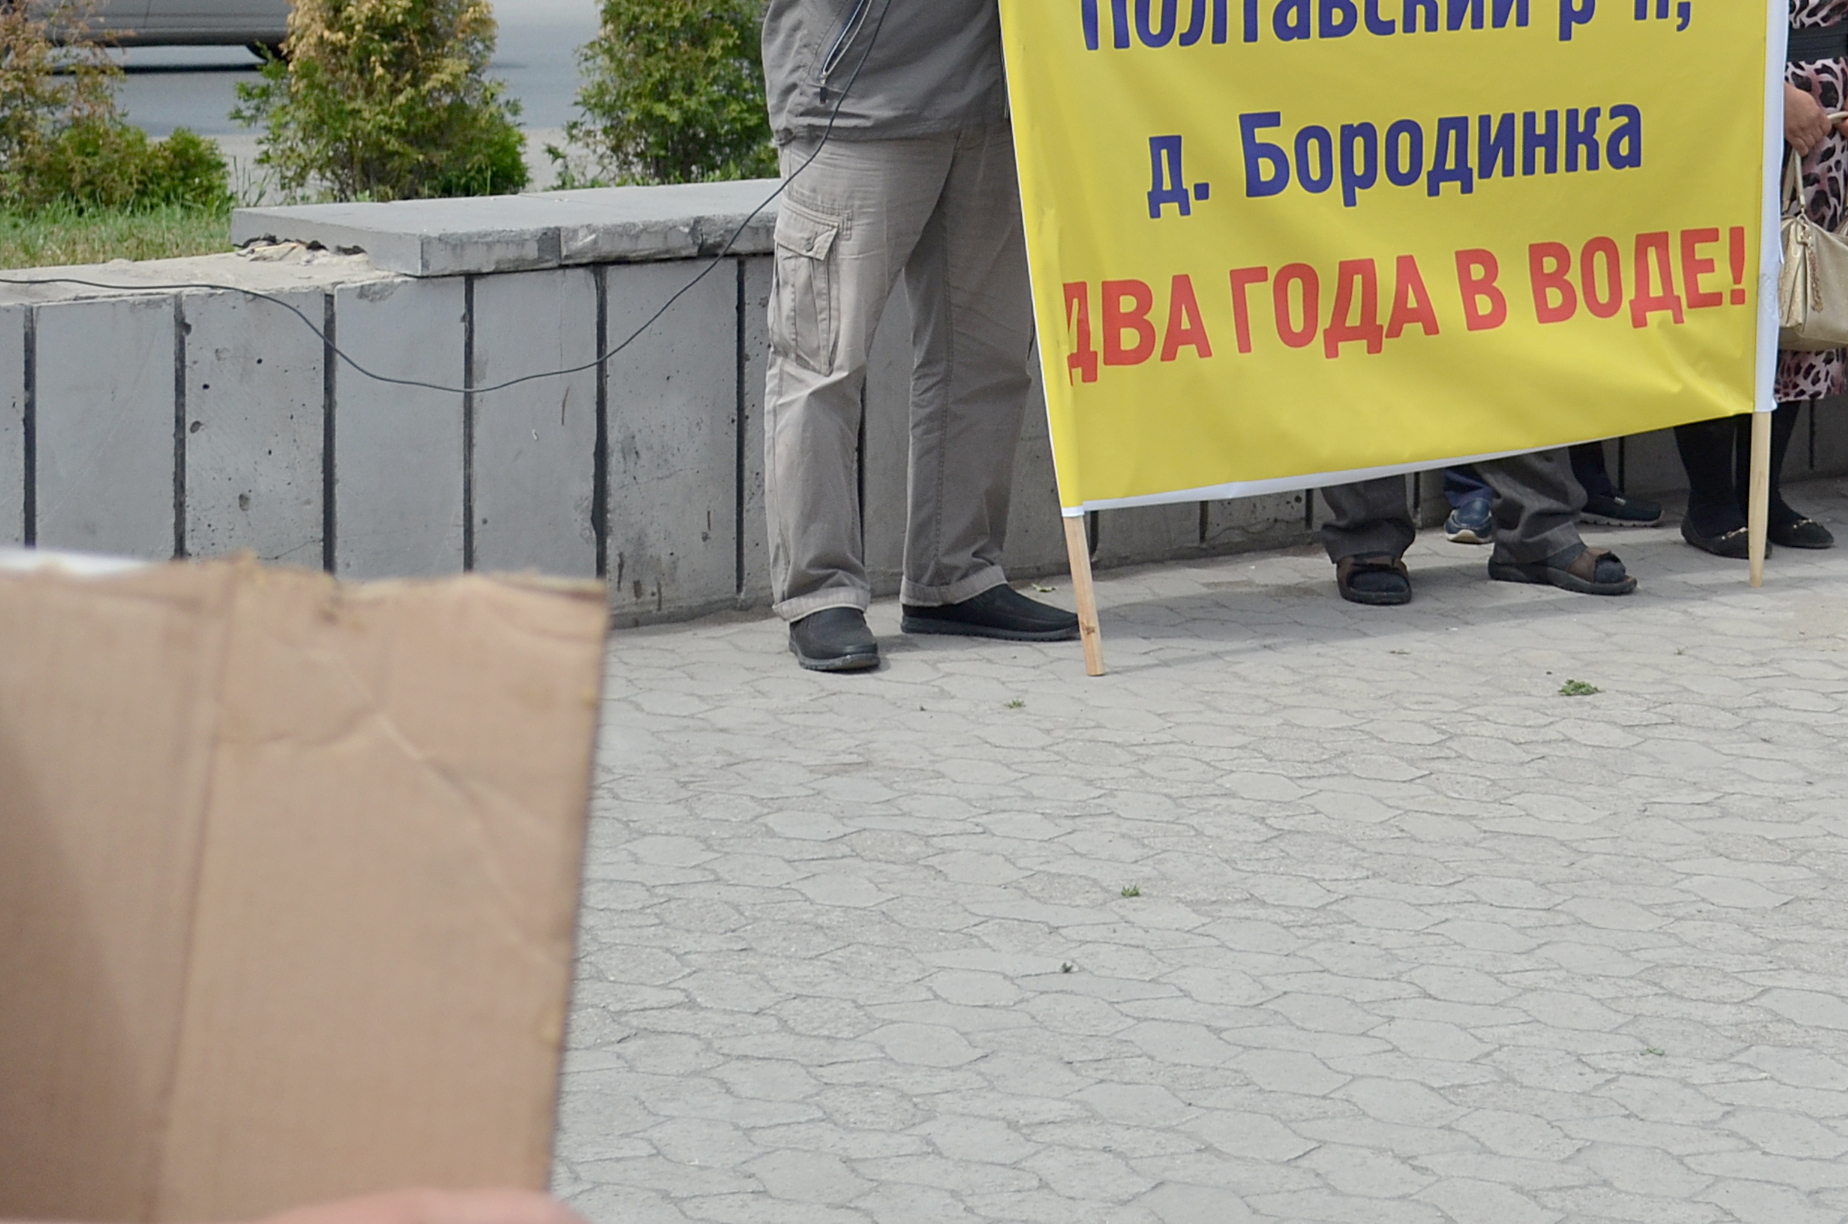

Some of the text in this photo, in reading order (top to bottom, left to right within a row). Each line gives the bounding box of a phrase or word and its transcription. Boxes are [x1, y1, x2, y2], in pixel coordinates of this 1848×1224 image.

[1146, 102, 1643, 220] д. Бородинка
[1062, 225, 1748, 387] ДВА ГОДА В ВОДЕ!
